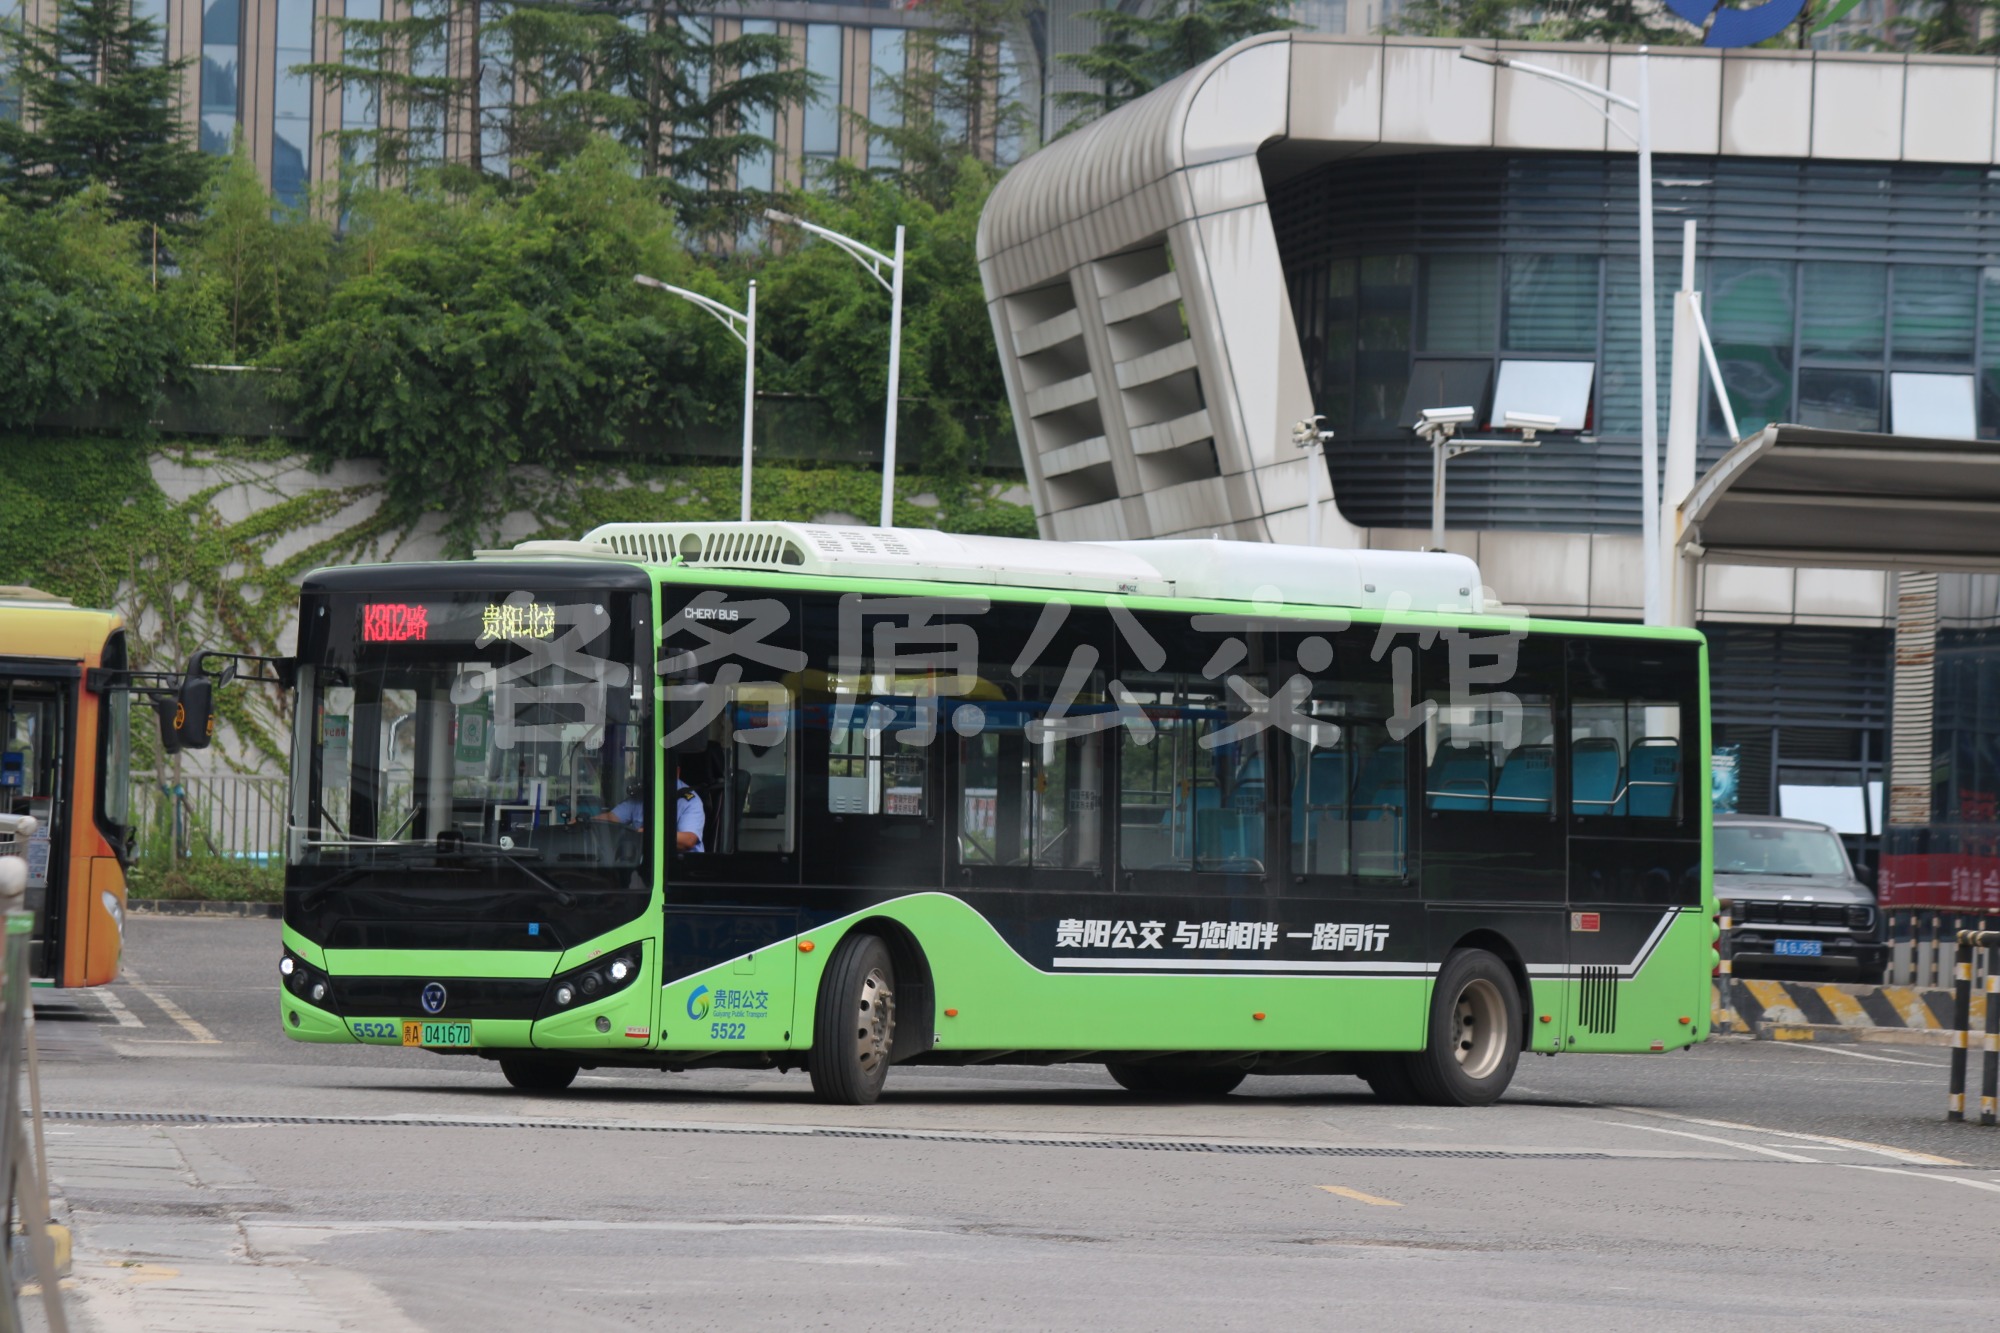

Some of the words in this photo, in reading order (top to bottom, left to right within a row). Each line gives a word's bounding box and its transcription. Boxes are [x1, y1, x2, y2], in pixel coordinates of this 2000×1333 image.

[364, 604, 429, 641] K802路
[684, 607, 717, 620] CHERY
[718, 609, 739, 621] BUS
[1055, 918, 1166, 949] 贵阳公交
[1172, 920, 1279, 950] 与您相伴
[1286, 922, 1390, 952] 一路同行
[713, 989, 769, 1010] 贵阳公交
[353, 1022, 398, 1039] 5522
[710, 1023, 746, 1040] 5522
